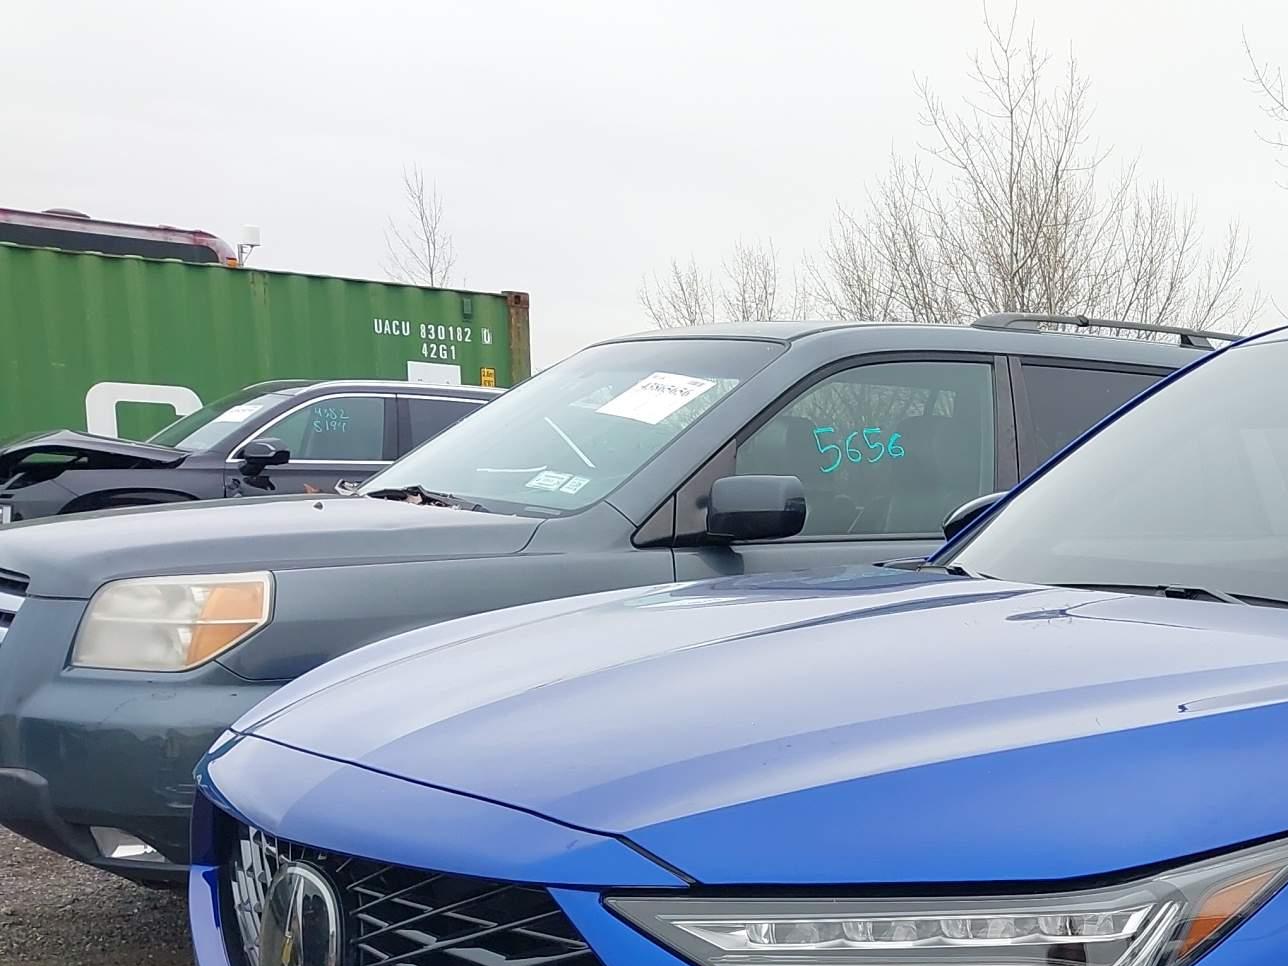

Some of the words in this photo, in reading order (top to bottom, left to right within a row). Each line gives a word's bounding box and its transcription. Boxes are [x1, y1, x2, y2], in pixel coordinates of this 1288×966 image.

[373, 319, 411, 336] UACU
[420, 323, 472, 342] 830182
[421, 343, 457, 360] 42G1
[813, 427, 905, 473] 5656
